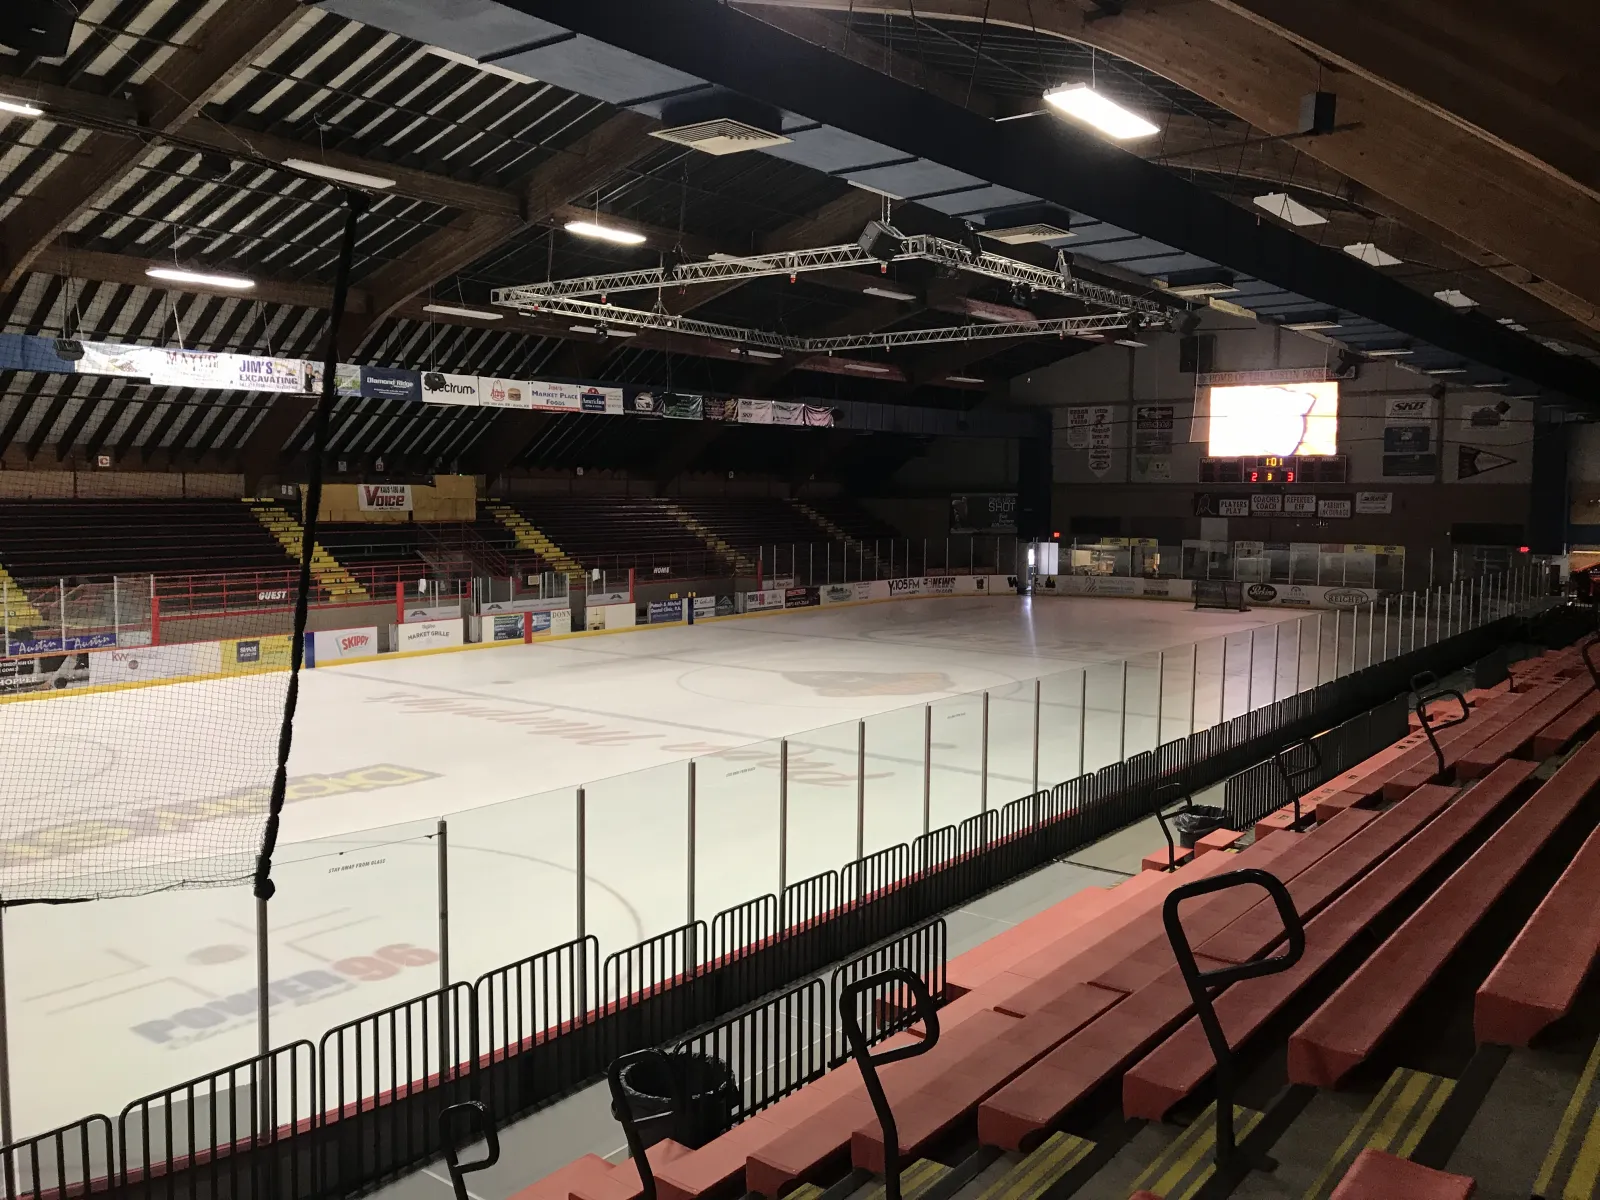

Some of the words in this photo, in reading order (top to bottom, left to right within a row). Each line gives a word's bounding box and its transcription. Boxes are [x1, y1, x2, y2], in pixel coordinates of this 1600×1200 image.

[239, 360, 273, 375] JIM'S
[239, 374, 298, 385] EXCAVATING
[1251, 472, 1258, 482] 2
[1267, 473, 1272, 481] 3
[1287, 472, 1294, 482] 3
[1253, 495, 1280, 503] COACHES
[988, 502, 1016, 512] SHOT
[1220, 501, 1247, 509] PLAYERS
[1256, 502, 1277, 510] COACH
[653, 566, 670, 574] HOME
[258, 590, 287, 601] GUEST
[407, 631, 430, 641] MARKET
[19, 640, 57, 653] Austin
[74, 635, 110, 648] Austin
[341, 635, 370, 651] SKIPPY
[340, 864, 355, 872] AWAY
[355, 861, 370, 869] FROM
[370, 858, 386, 866] GLASS
